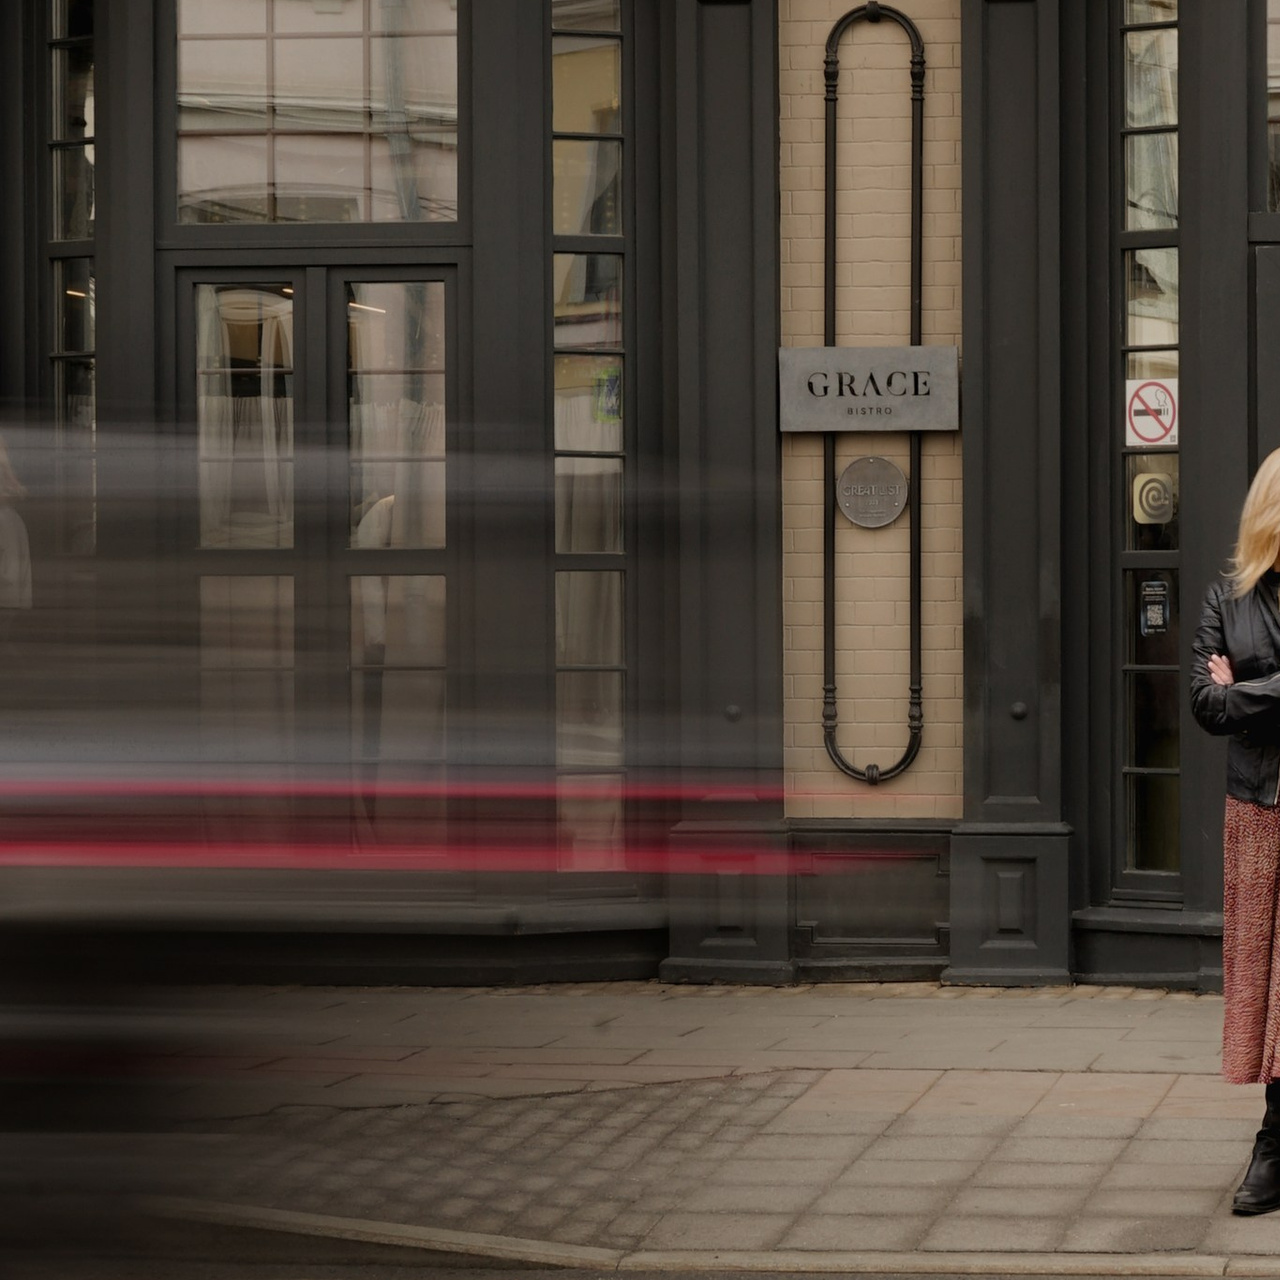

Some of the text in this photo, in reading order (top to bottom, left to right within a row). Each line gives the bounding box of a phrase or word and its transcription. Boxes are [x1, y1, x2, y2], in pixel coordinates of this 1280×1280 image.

[807, 370, 931, 398] GRACE
[847, 407, 893, 416] BISTRO
[843, 484, 901, 496] GREAT LIST
